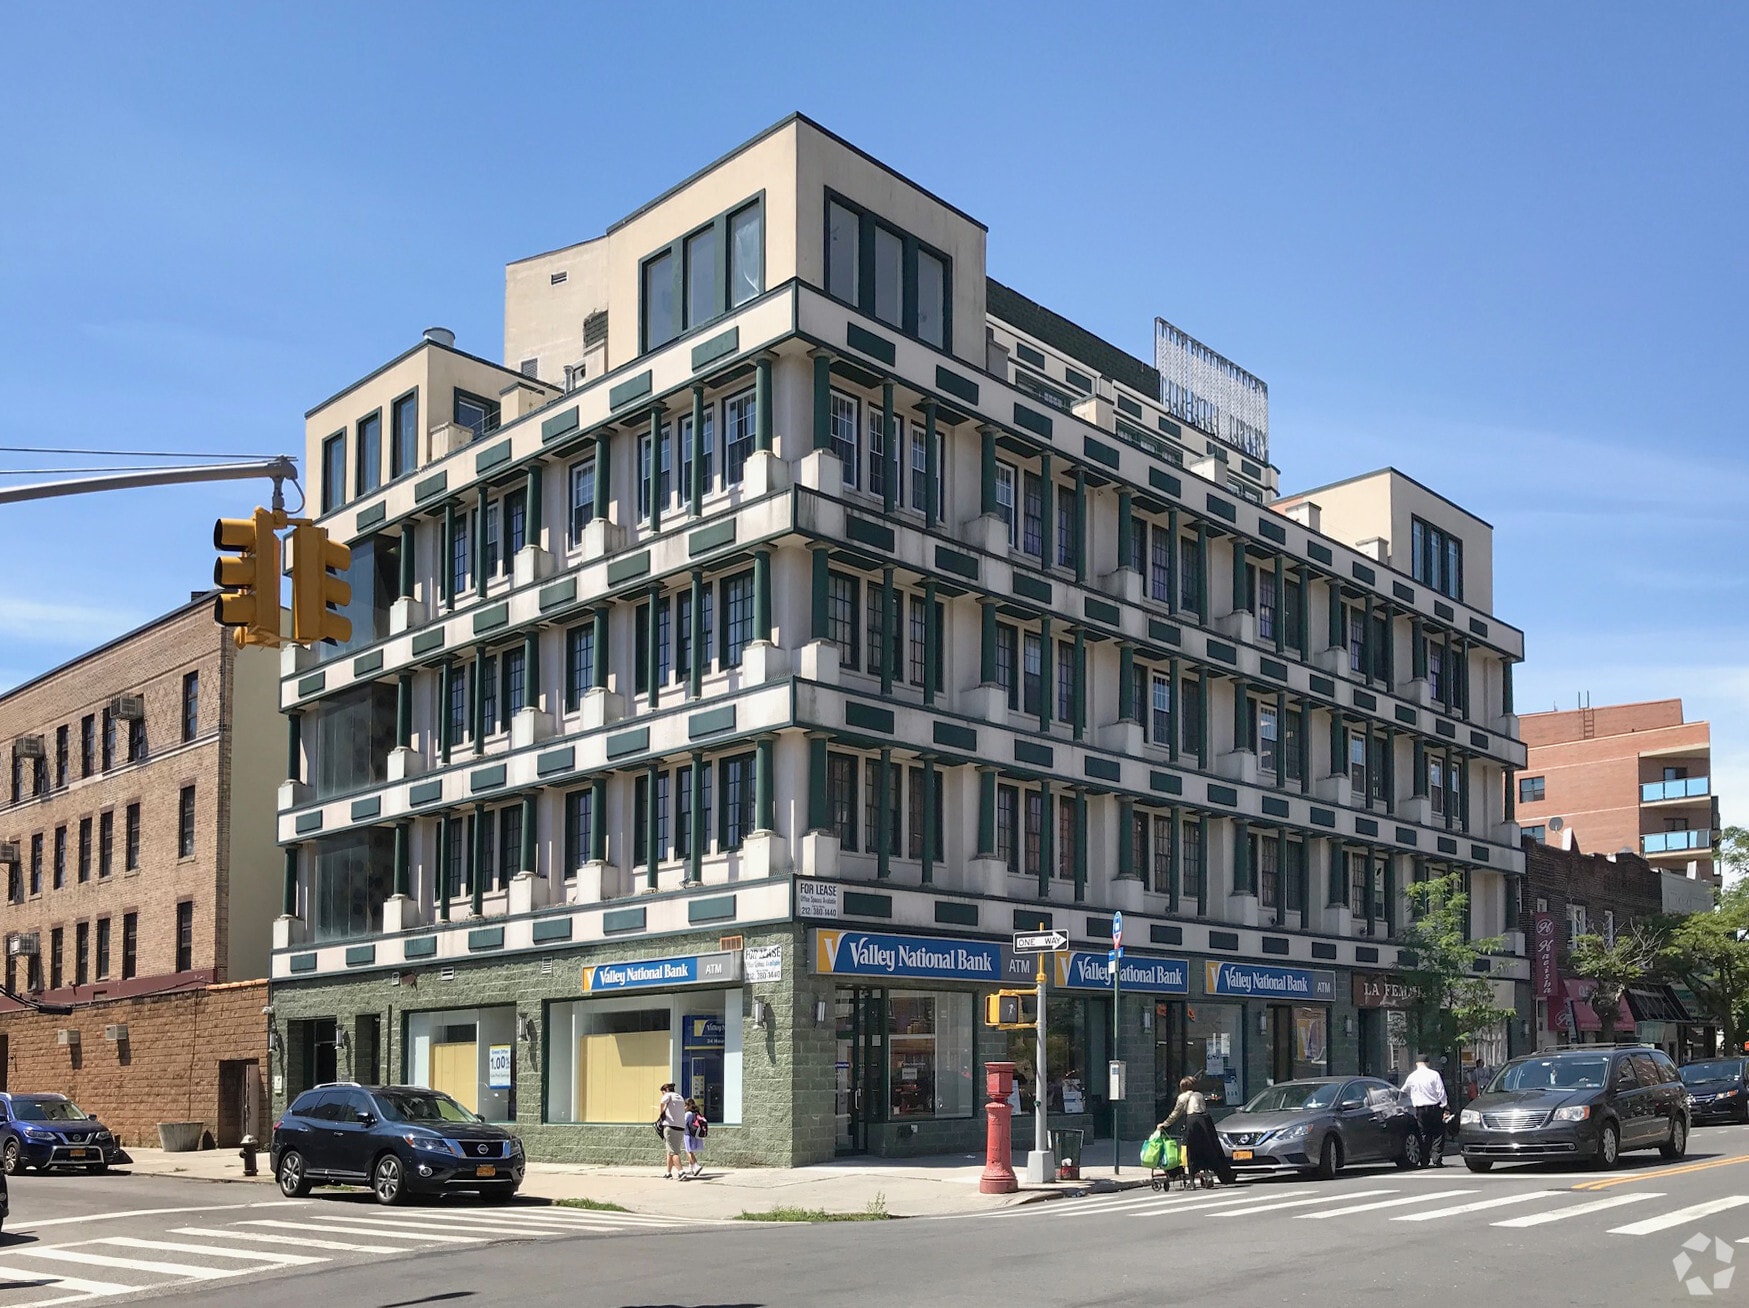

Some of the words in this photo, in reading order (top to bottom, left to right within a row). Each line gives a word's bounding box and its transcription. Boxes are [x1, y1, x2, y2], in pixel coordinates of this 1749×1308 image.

[801, 882, 814, 894] FOR
[816, 884, 837, 896] LEASE
[1018, 938, 1036, 947] ONE
[1044, 936, 1062, 945] WAY
[849, 937, 895, 972] Valley
[898, 945, 955, 970] National
[957, 949, 993, 972] Bank
[1008, 958, 1031, 974] ATM
[600, 966, 626, 986] Valley
[626, 964, 663, 982] National
[664, 963, 688, 978] Bank
[705, 963, 722, 975] ATM
[1077, 956, 1111, 986] Valley
[1156, 965, 1183, 985] Bank
[1224, 966, 1252, 993] Valley
[1253, 972, 1286, 991] National
[1287, 975, 1308, 992] Bank
[1317, 982, 1331, 993] ATM
[1363, 982, 1380, 996] LA
